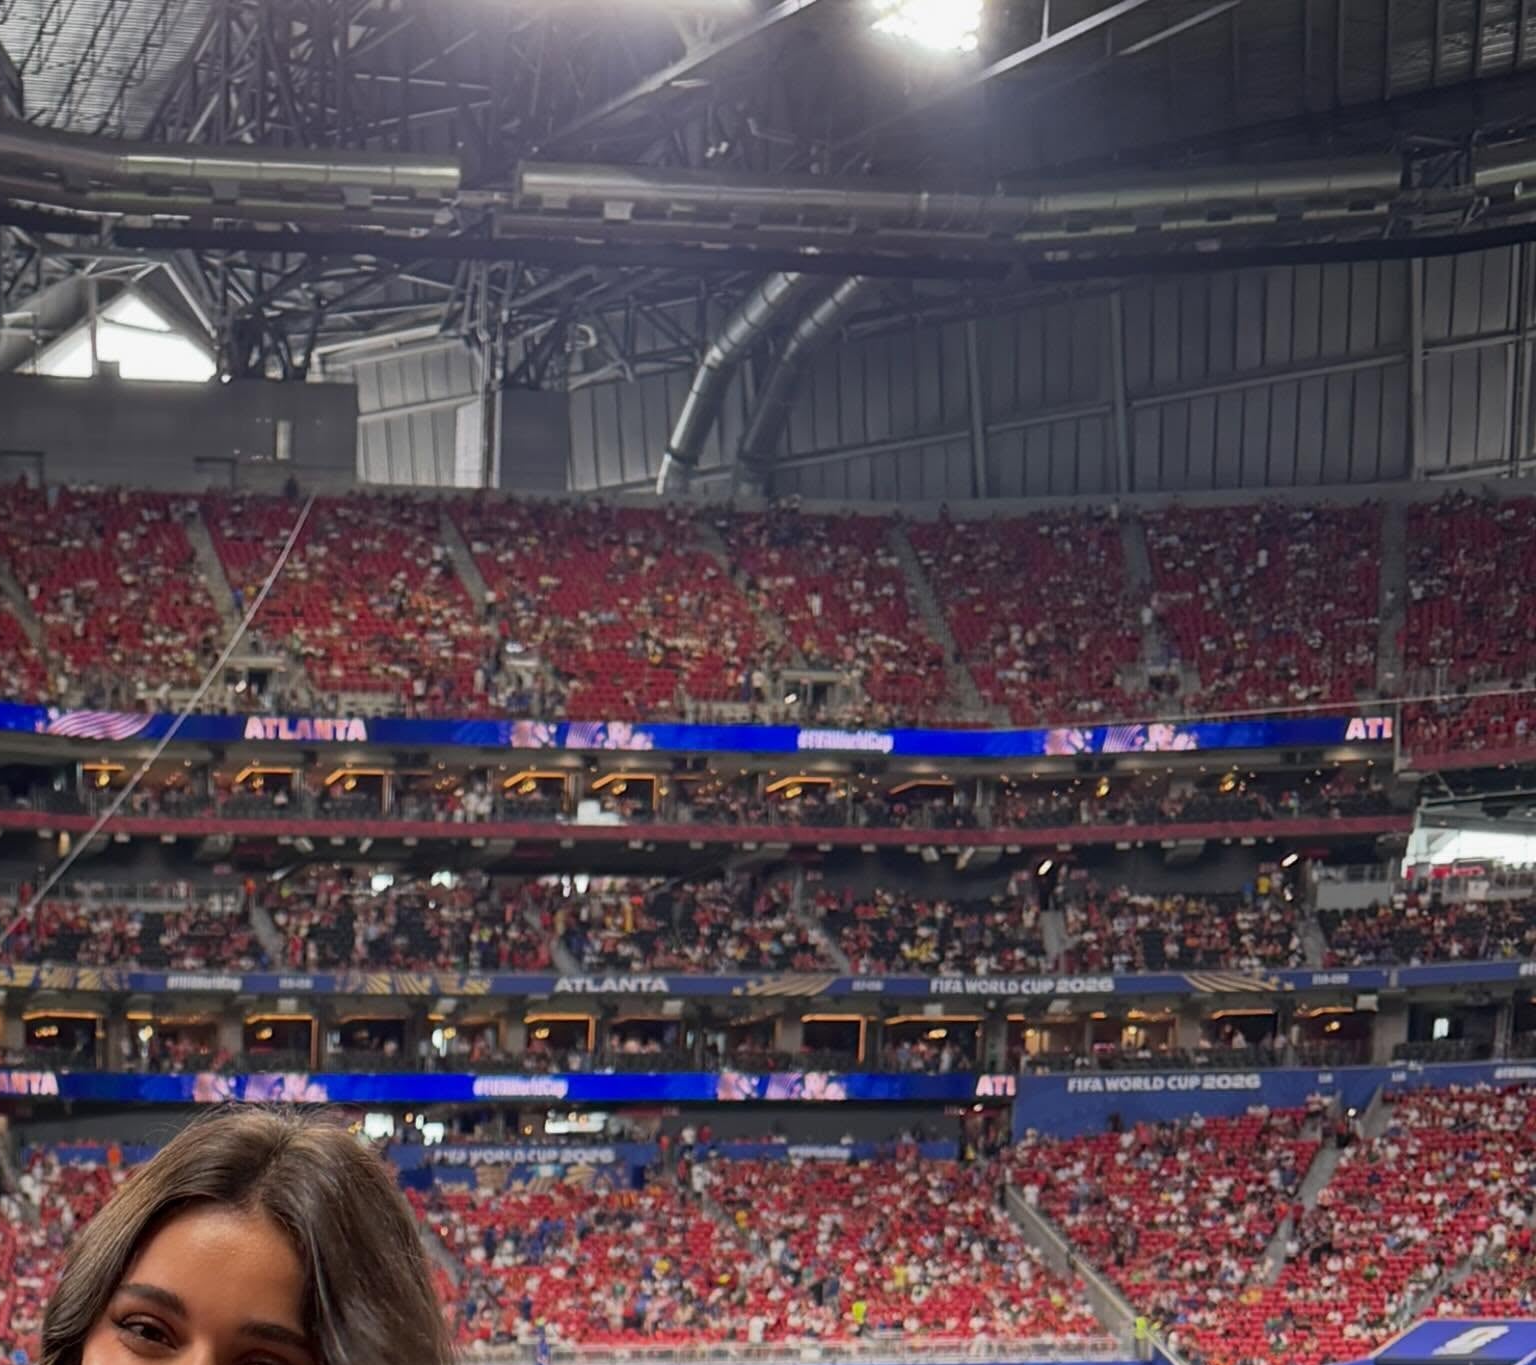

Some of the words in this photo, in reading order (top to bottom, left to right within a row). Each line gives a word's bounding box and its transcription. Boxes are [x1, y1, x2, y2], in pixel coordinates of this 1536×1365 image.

[244, 717, 366, 741] ATLANTA
[554, 977, 669, 993] ATLANTA
[930, 978, 964, 993] FIFA
[965, 978, 1019, 994] WORLD
[1020, 979, 1054, 994] CUP
[1055, 976, 1114, 993] 2026
[1068, 1077, 1104, 1092] FIFA
[1105, 1076, 1165, 1092] WORLD
[1167, 1075, 1200, 1091] CUP
[1202, 1074, 1261, 1090] 2026
